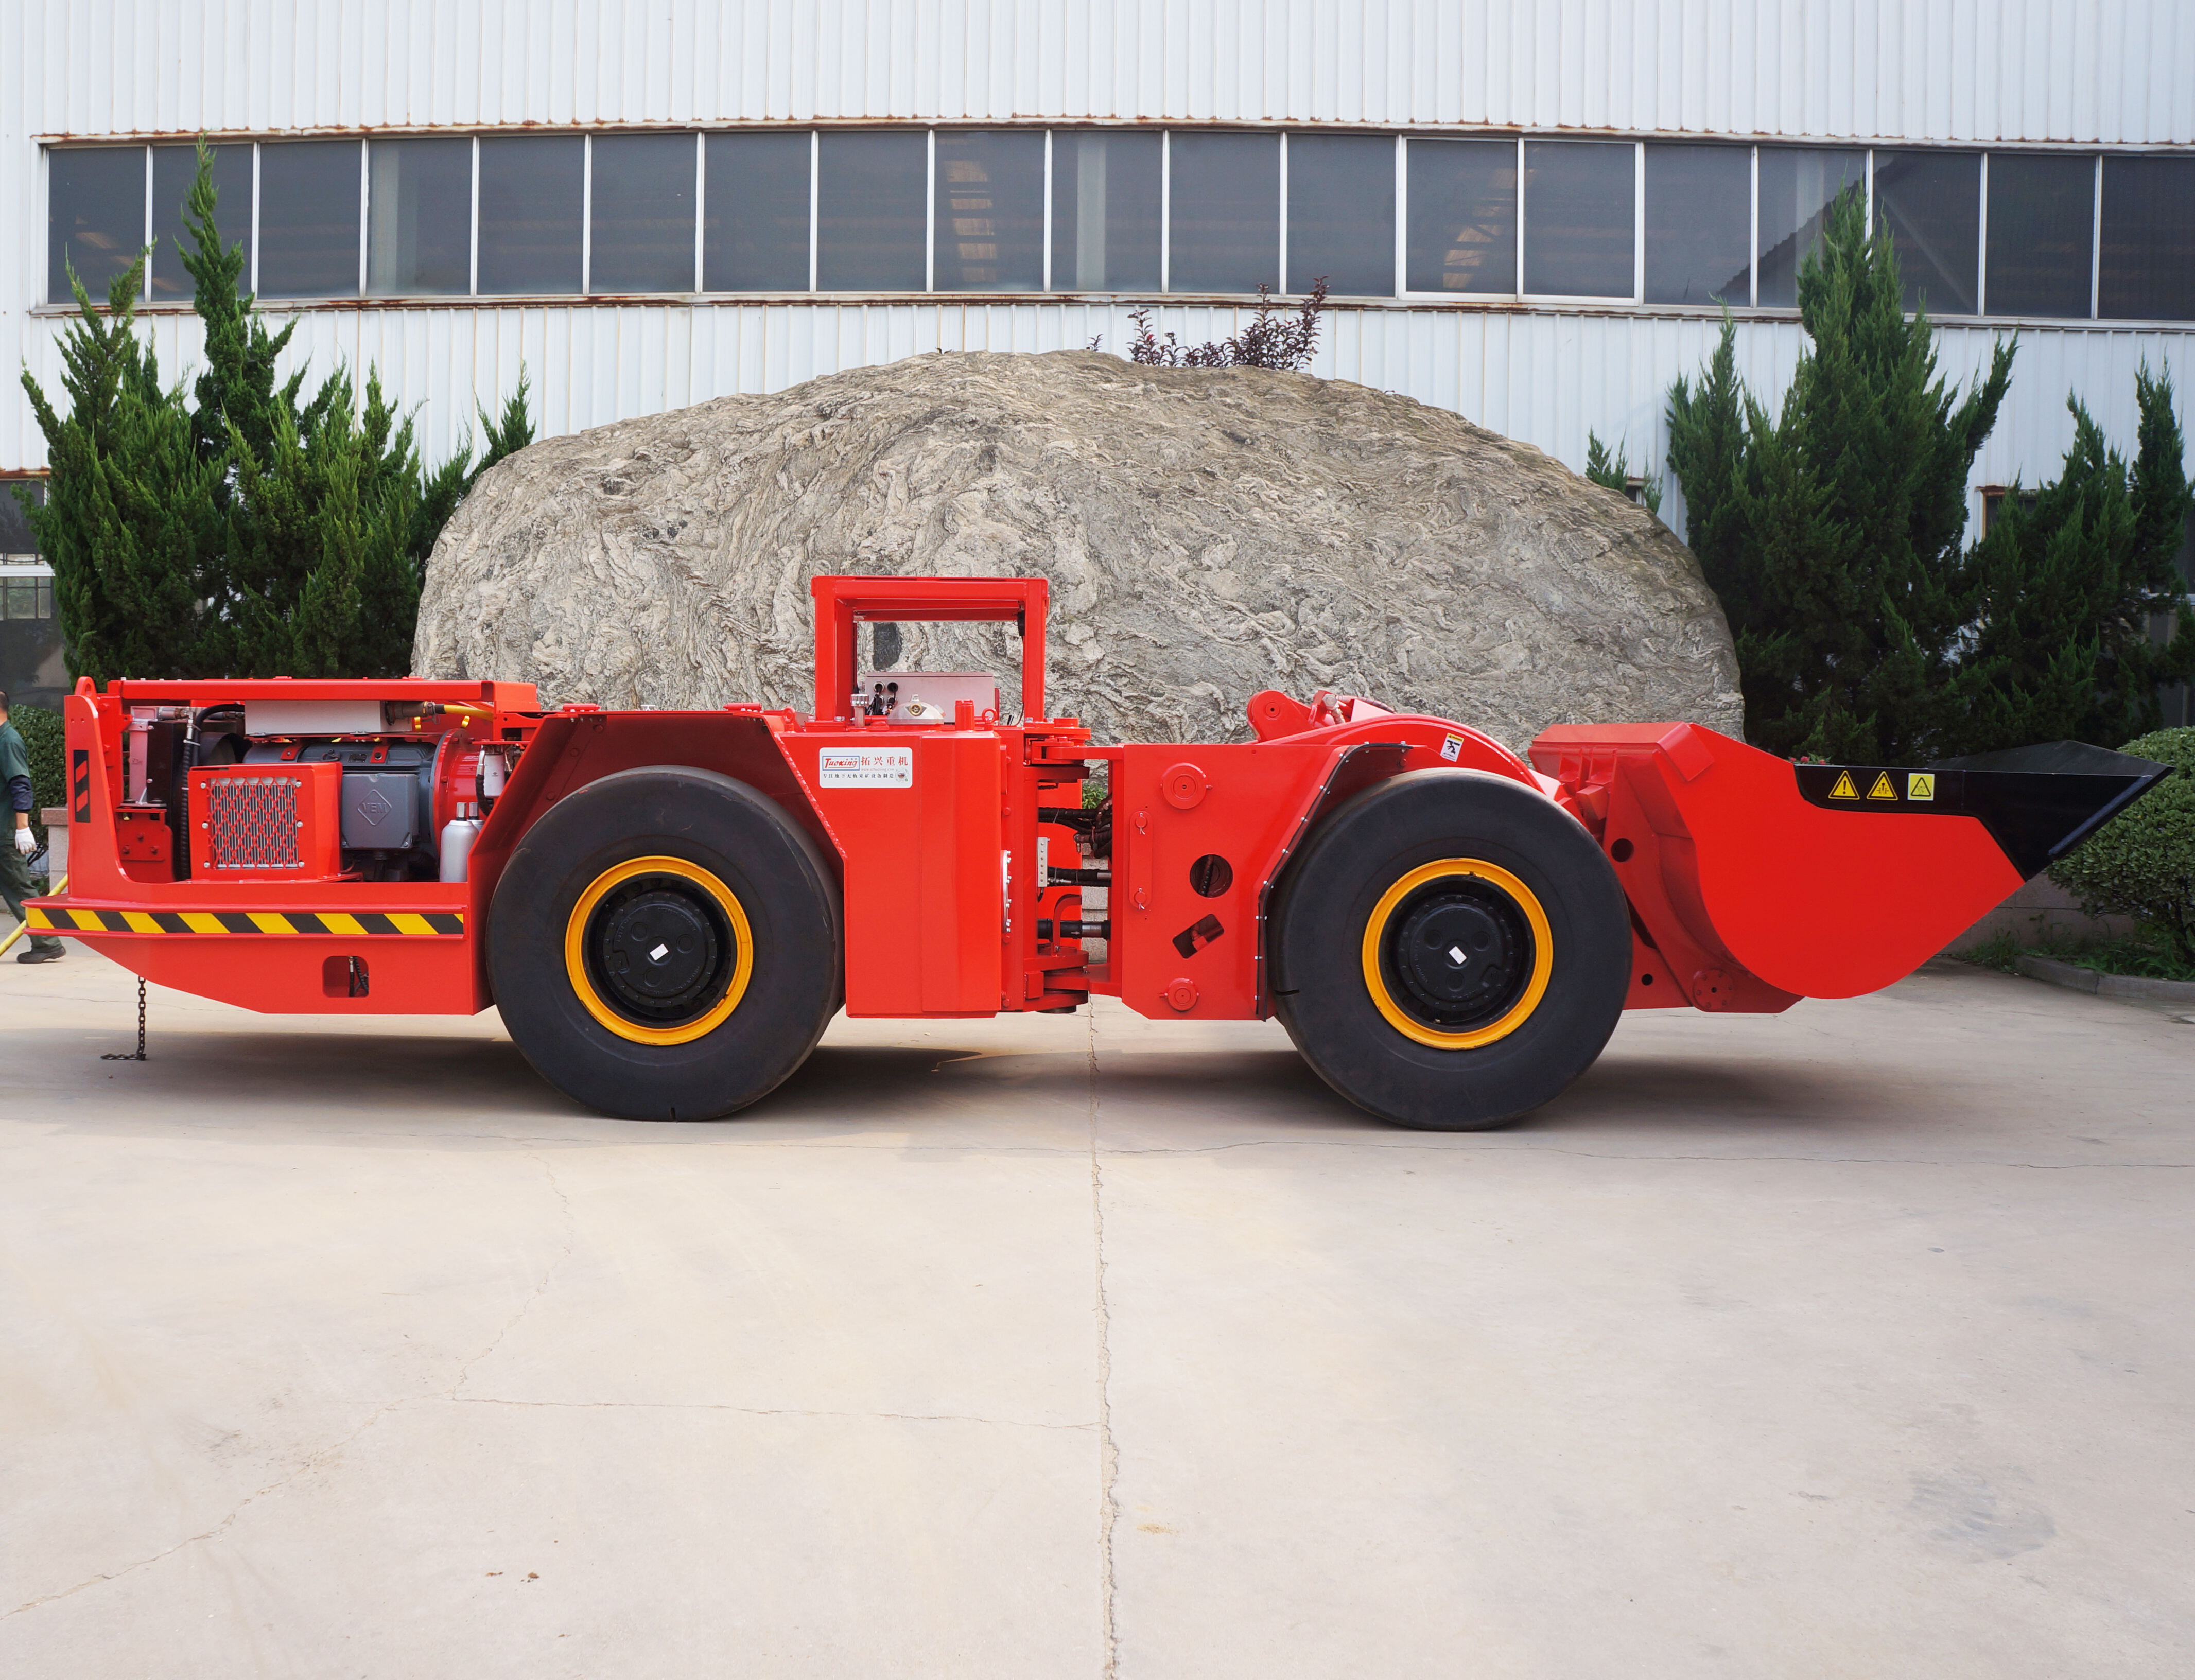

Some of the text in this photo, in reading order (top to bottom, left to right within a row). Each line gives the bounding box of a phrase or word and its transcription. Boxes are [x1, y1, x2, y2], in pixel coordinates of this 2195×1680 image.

[861, 756, 908, 766] 拓兴重机
[362, 802, 388, 813] VEM
